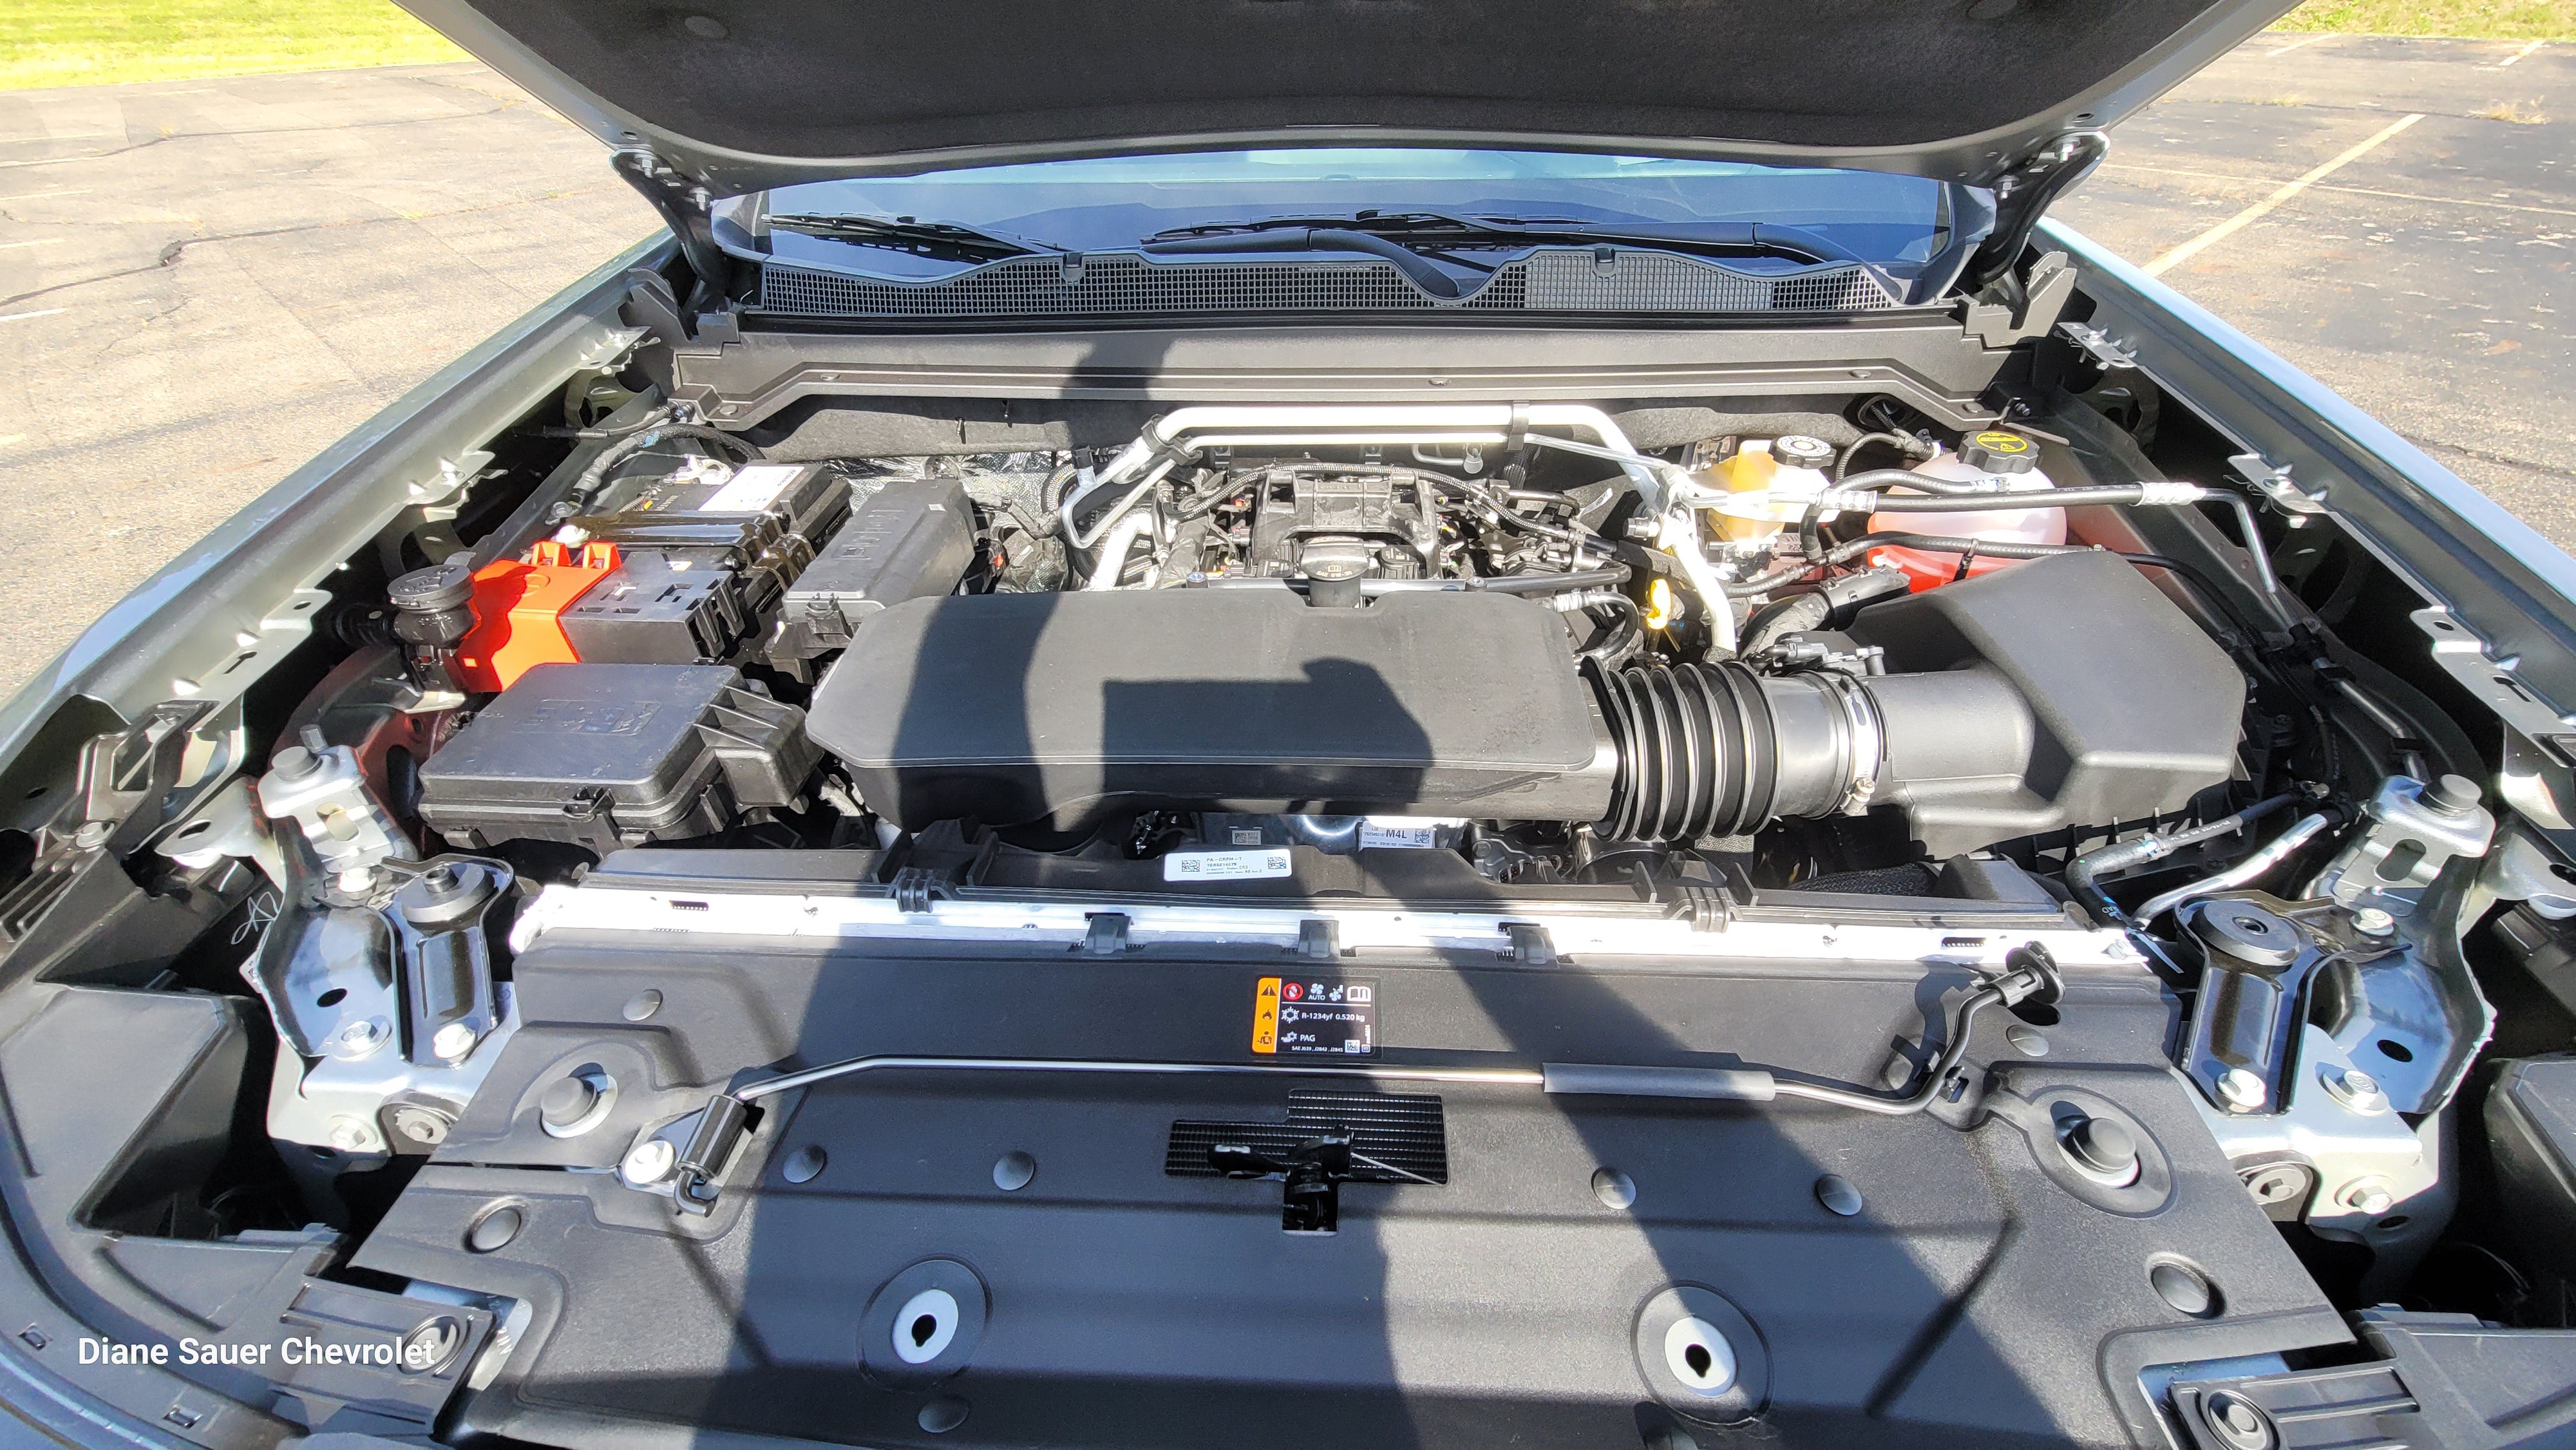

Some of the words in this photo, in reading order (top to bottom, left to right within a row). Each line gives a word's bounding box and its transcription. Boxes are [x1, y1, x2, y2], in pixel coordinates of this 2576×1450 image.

[1386, 829, 1407, 839] M4L
[1302, 1012, 1333, 1021] R-1234yf
[1356, 1013, 1365, 1022] kg
